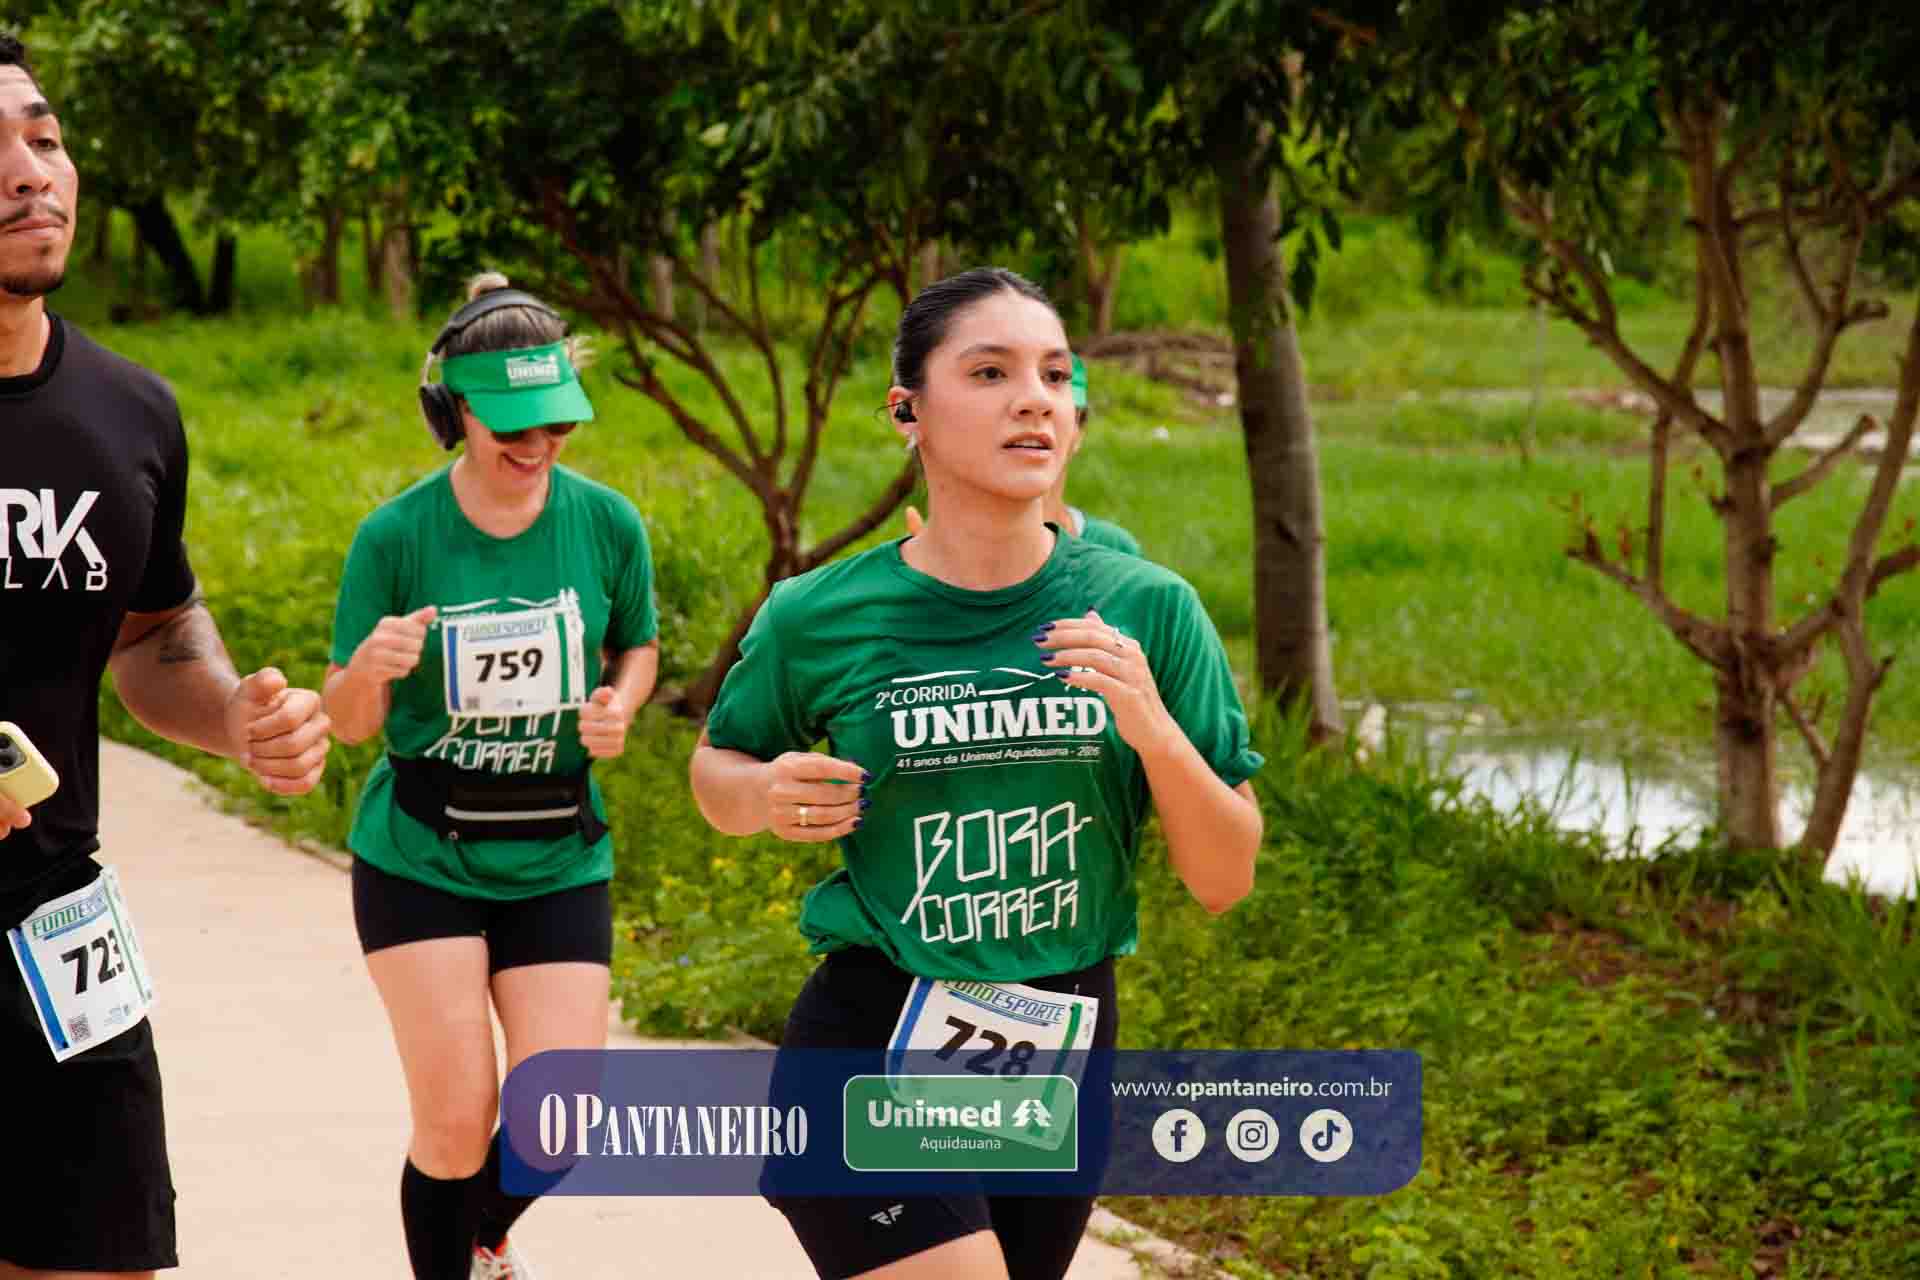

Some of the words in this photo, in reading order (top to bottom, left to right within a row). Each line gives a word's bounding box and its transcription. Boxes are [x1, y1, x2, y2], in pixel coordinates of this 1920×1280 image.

[475, 647, 543, 683] 759
[890, 682, 977, 706] CORRIDA
[891, 696, 1107, 748] UNIMED
[452, 738, 557, 774] CORRER
[896, 757, 910, 769] 41
[913, 756, 941, 767] anos
[943, 753, 958, 765] da
[959, 748, 1001, 763] Unimed
[900, 801, 1093, 925] BORA
[918, 878, 1079, 944] CORRER
[943, 979, 1066, 1022] UNDESPORTE
[934, 1015, 1036, 1082] 728
